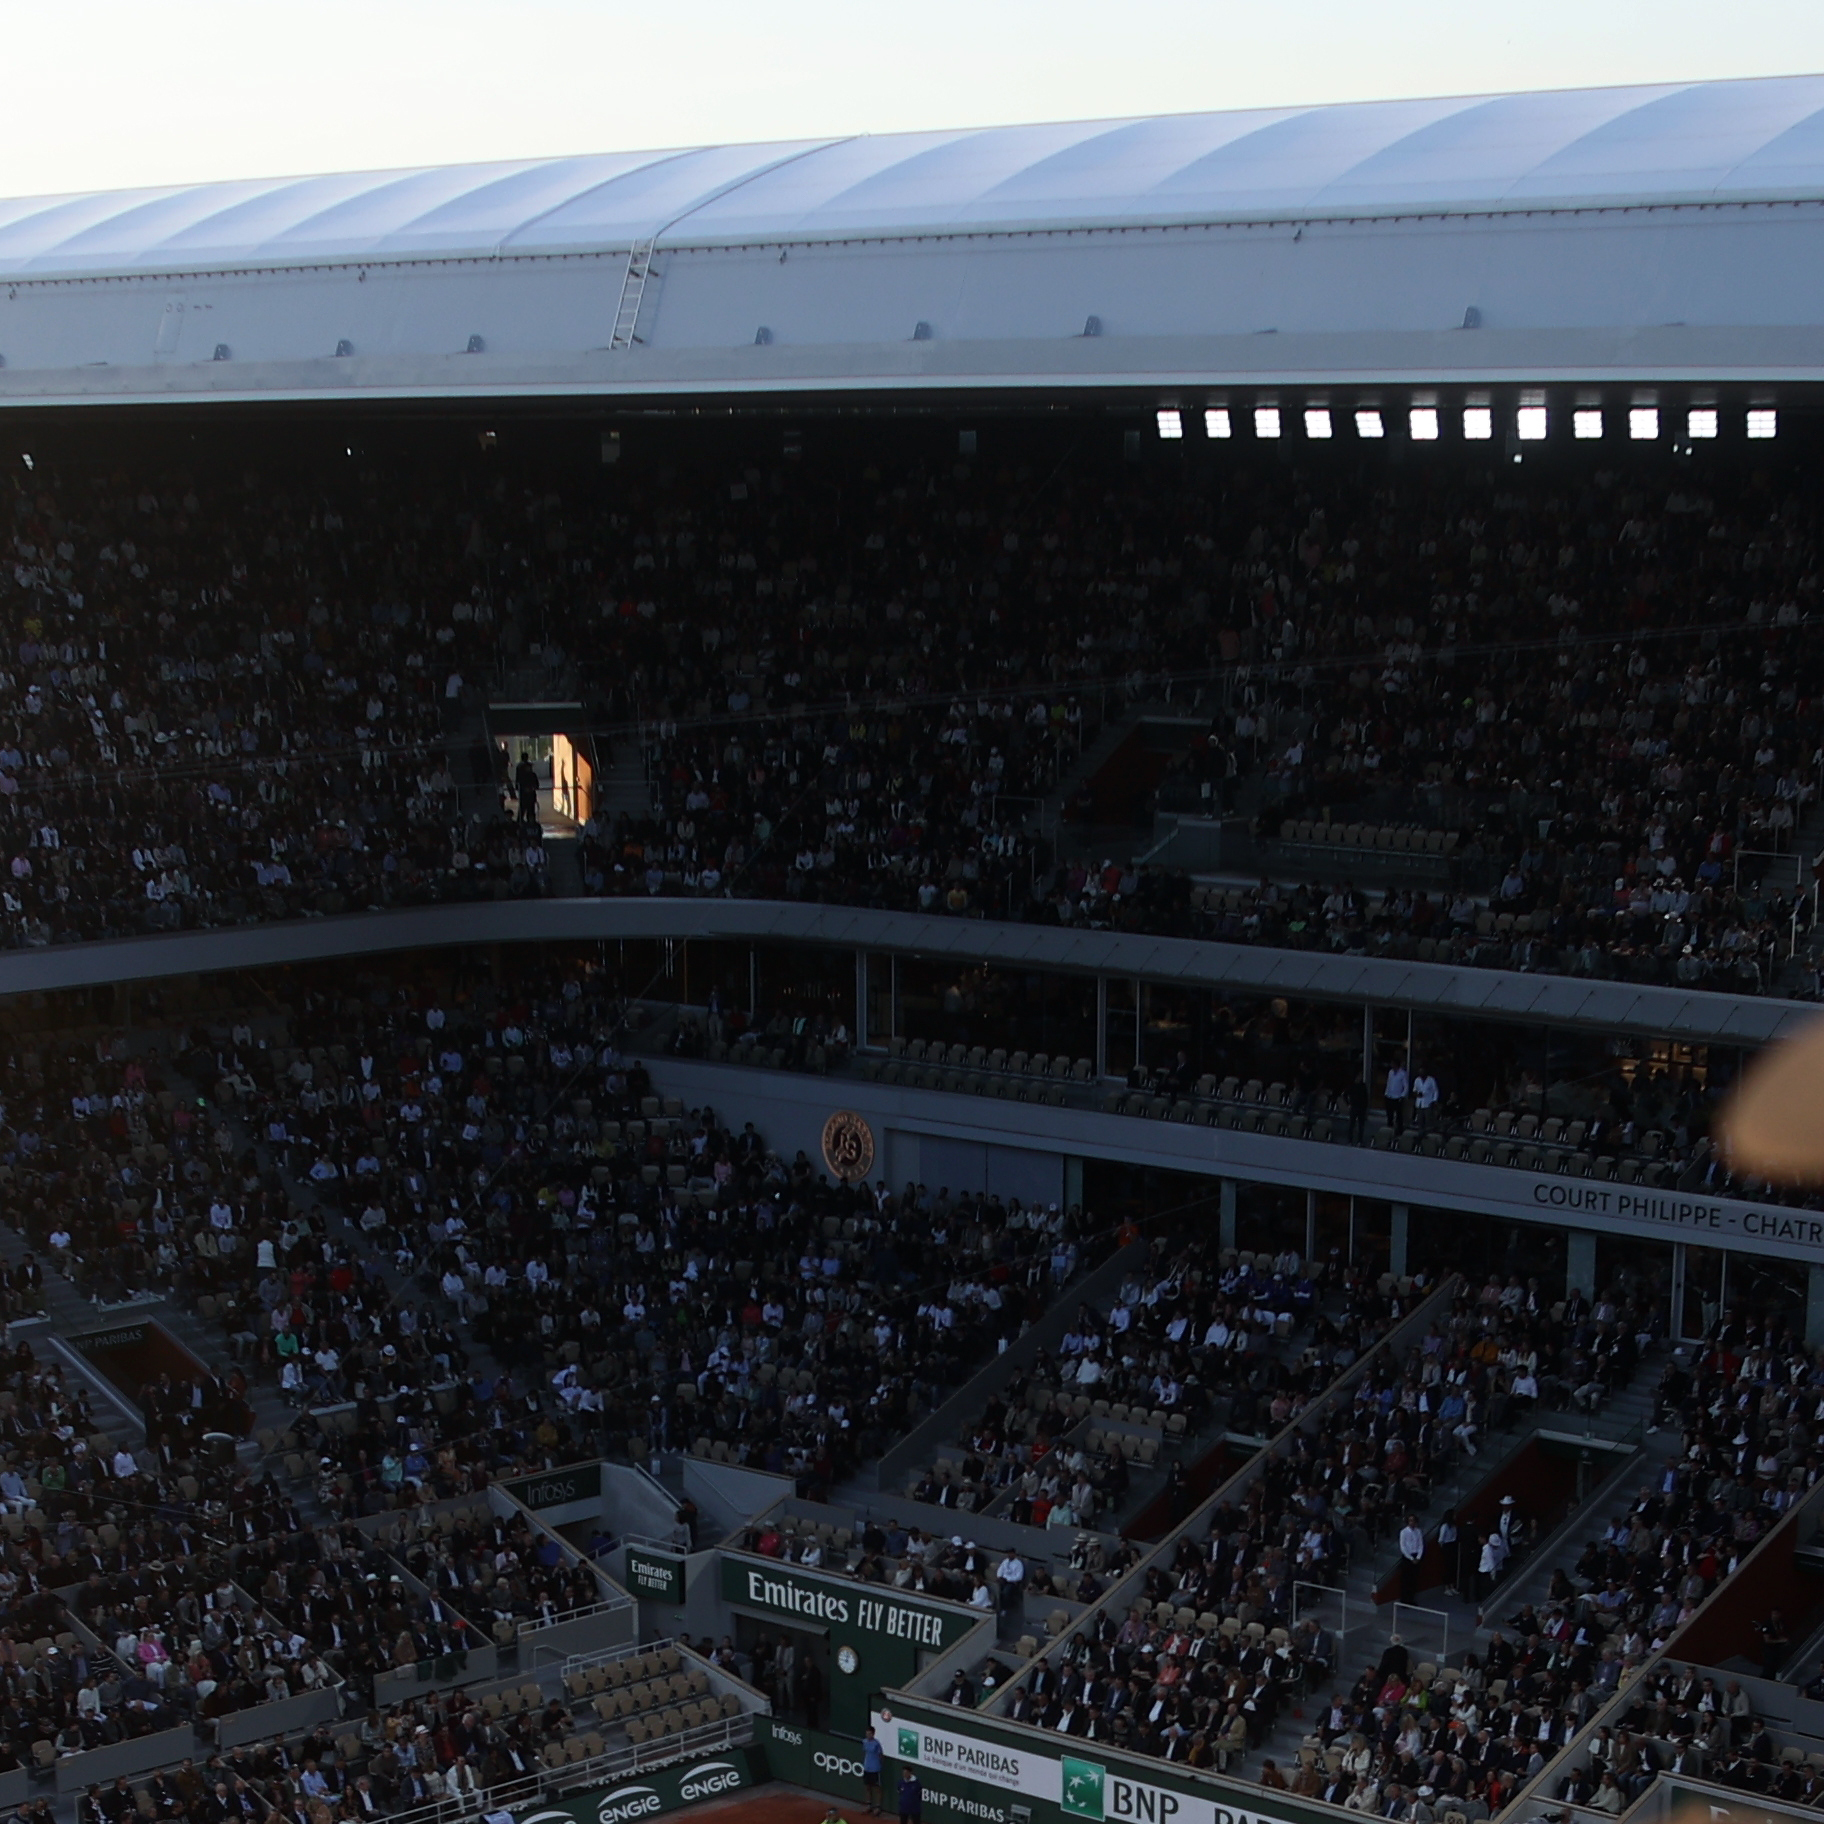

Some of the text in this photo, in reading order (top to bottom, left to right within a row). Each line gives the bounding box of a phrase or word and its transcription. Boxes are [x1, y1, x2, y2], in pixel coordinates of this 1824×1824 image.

[1534, 1183, 1611, 1211] COURT
[1618, 1195, 1721, 1228] PHILIPPE
[527, 1479, 575, 1506] Infosys
[631, 1559, 673, 1581] Emirates
[638, 1575, 668, 1591] FLY BETTER
[748, 1571, 942, 1646] Emirates FLY BETTER
[771, 1723, 802, 1746] Infosys
[813, 1751, 864, 1776] oppo
[924, 1736, 1019, 1775] BNP PARIBAS
[921, 1788, 1004, 1823] BNP PARIBAS
